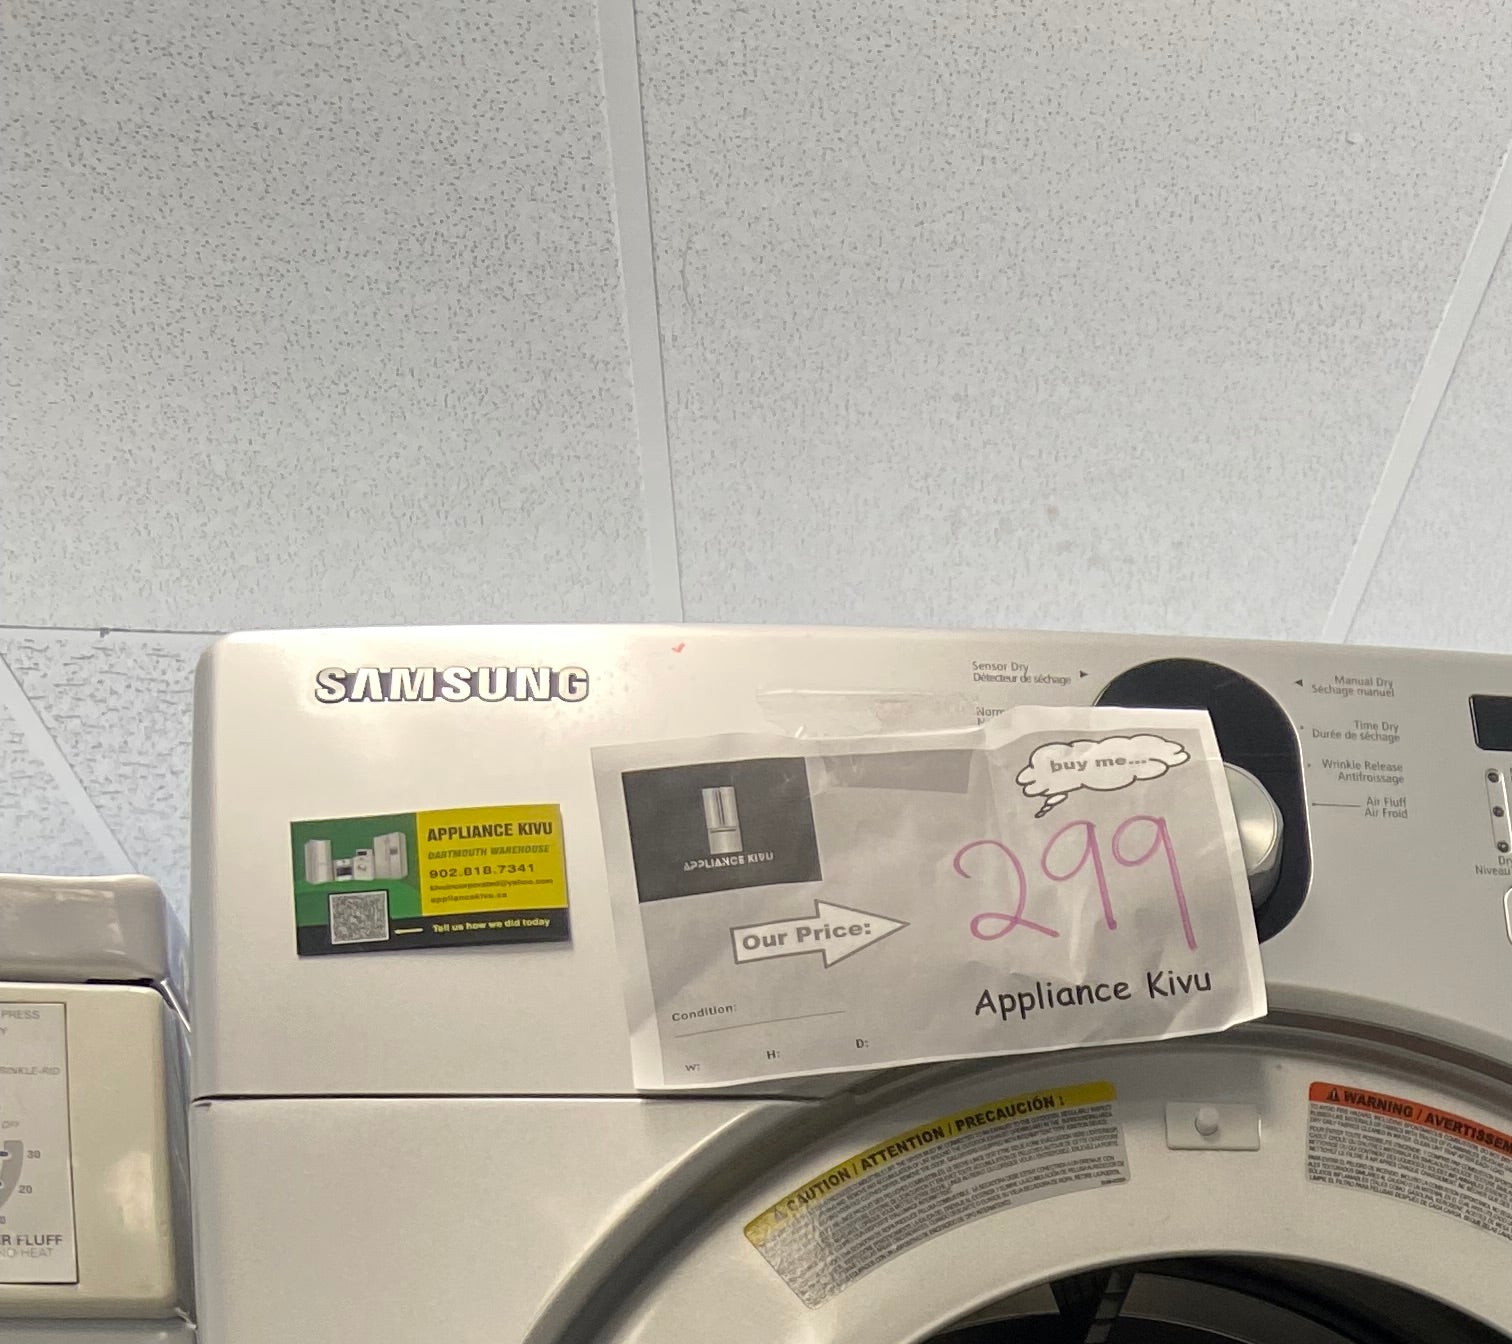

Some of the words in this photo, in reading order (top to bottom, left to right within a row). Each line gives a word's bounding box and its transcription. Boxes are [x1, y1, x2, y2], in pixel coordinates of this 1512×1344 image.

[972, 660, 1008, 671] Sensor
[1011, 661, 1029, 676] Dry
[315, 667, 590, 703] SAMSUNG
[1334, 675, 1373, 686] Manual
[1376, 677, 1393, 689] Dry
[1357, 687, 1394, 697] manuel
[1354, 720, 1378, 730] Time
[1382, 721, 1399, 733] Dry
[1312, 729, 1341, 738] Durée
[1345, 730, 1357, 740] de
[1051, 757, 1088, 773] buy
[1322, 759, 1361, 770] Wrinkle
[1365, 761, 1403, 771] Release
[1338, 772, 1404, 785] Antifroissage
[1366, 797, 1380, 806] Air
[1384, 797, 1406, 807] Fluff
[1365, 808, 1379, 818] Air
[1383, 808, 1408, 819] Froid
[427, 822, 513, 842] APPLIANCE
[518, 821, 553, 836] KIVU
[428, 847, 487, 860] DARTMOUTH
[490, 844, 550, 856] WAREHOUSE
[683, 856, 745, 872] APPLIANCE
[747, 851, 774, 863] KIVU
[429, 863, 535, 879] 902.818.7341
[1475, 865, 1511, 877] Niveau
[953, 815, 1198, 951] 299
[432, 924, 450, 933] Tell
[452, 923, 464, 932] us
[466, 921, 487, 931] how
[488, 921, 502, 929] we
[504, 919, 521, 928] did
[523, 918, 551, 928] today
[742, 931, 788, 951] Our
[796, 921, 872, 943] Price:
[975, 982, 1132, 1021] Appliance
[1147, 970, 1212, 999] Kivu
[1, 1009, 41, 1020] PRESS
[672, 1003, 737, 1022] Condition:
[766, 1050, 780, 1060] H:
[855, 1038, 870, 1050] D:
[1343, 1090, 1414, 1118] WARNING
[27, 1150, 41, 1159] 30
[787, 1163, 852, 1217] CAUTION
[860, 1125, 946, 1171] ATTENTION
[955, 1093, 1056, 1132] PRECAUCIÓN
[19, 1184, 33, 1194] 20
[17, 1234, 63, 1246] FLUFF
